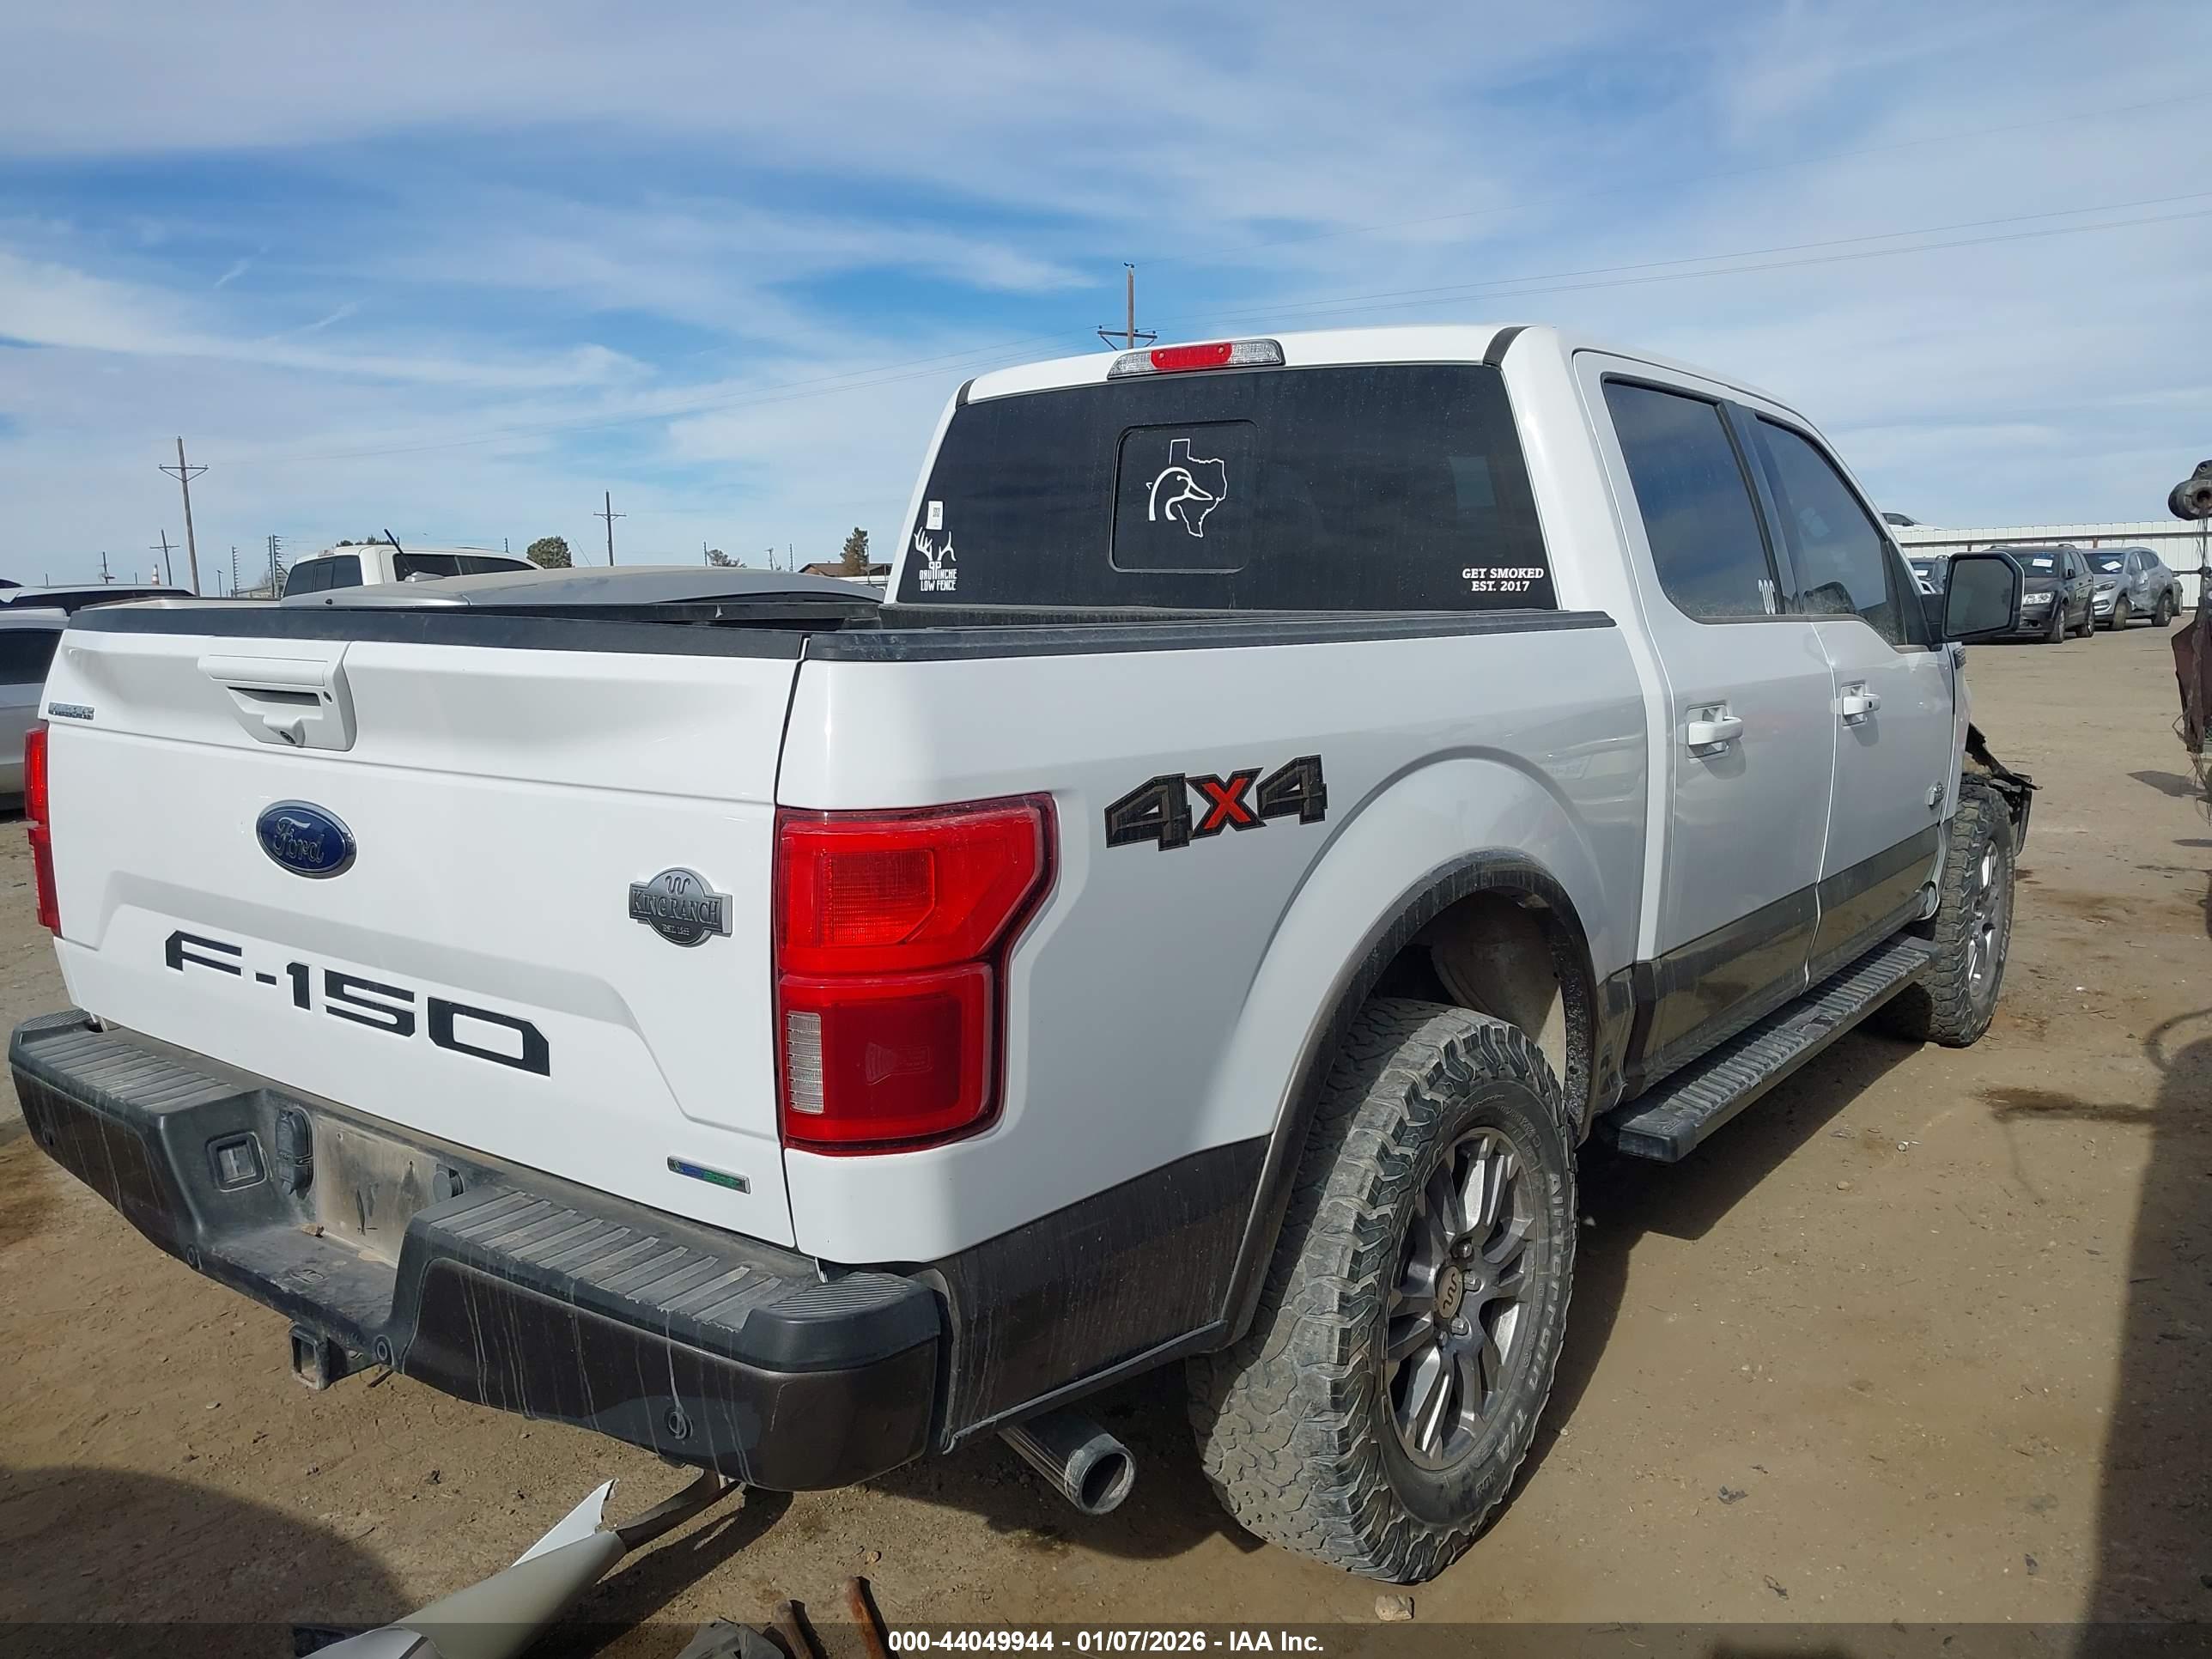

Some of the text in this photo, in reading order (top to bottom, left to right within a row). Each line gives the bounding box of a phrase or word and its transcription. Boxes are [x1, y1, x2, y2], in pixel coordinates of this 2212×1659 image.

[920, 579, 957, 592] LOW FENCE
[1462, 568, 1545, 579] GET SMOKED
[1471, 580, 1530, 592] EST. 2017
[274, 816, 325, 864] Ford
[632, 889, 720, 926] KING RANCH
[165, 929, 550, 1078] F-150
